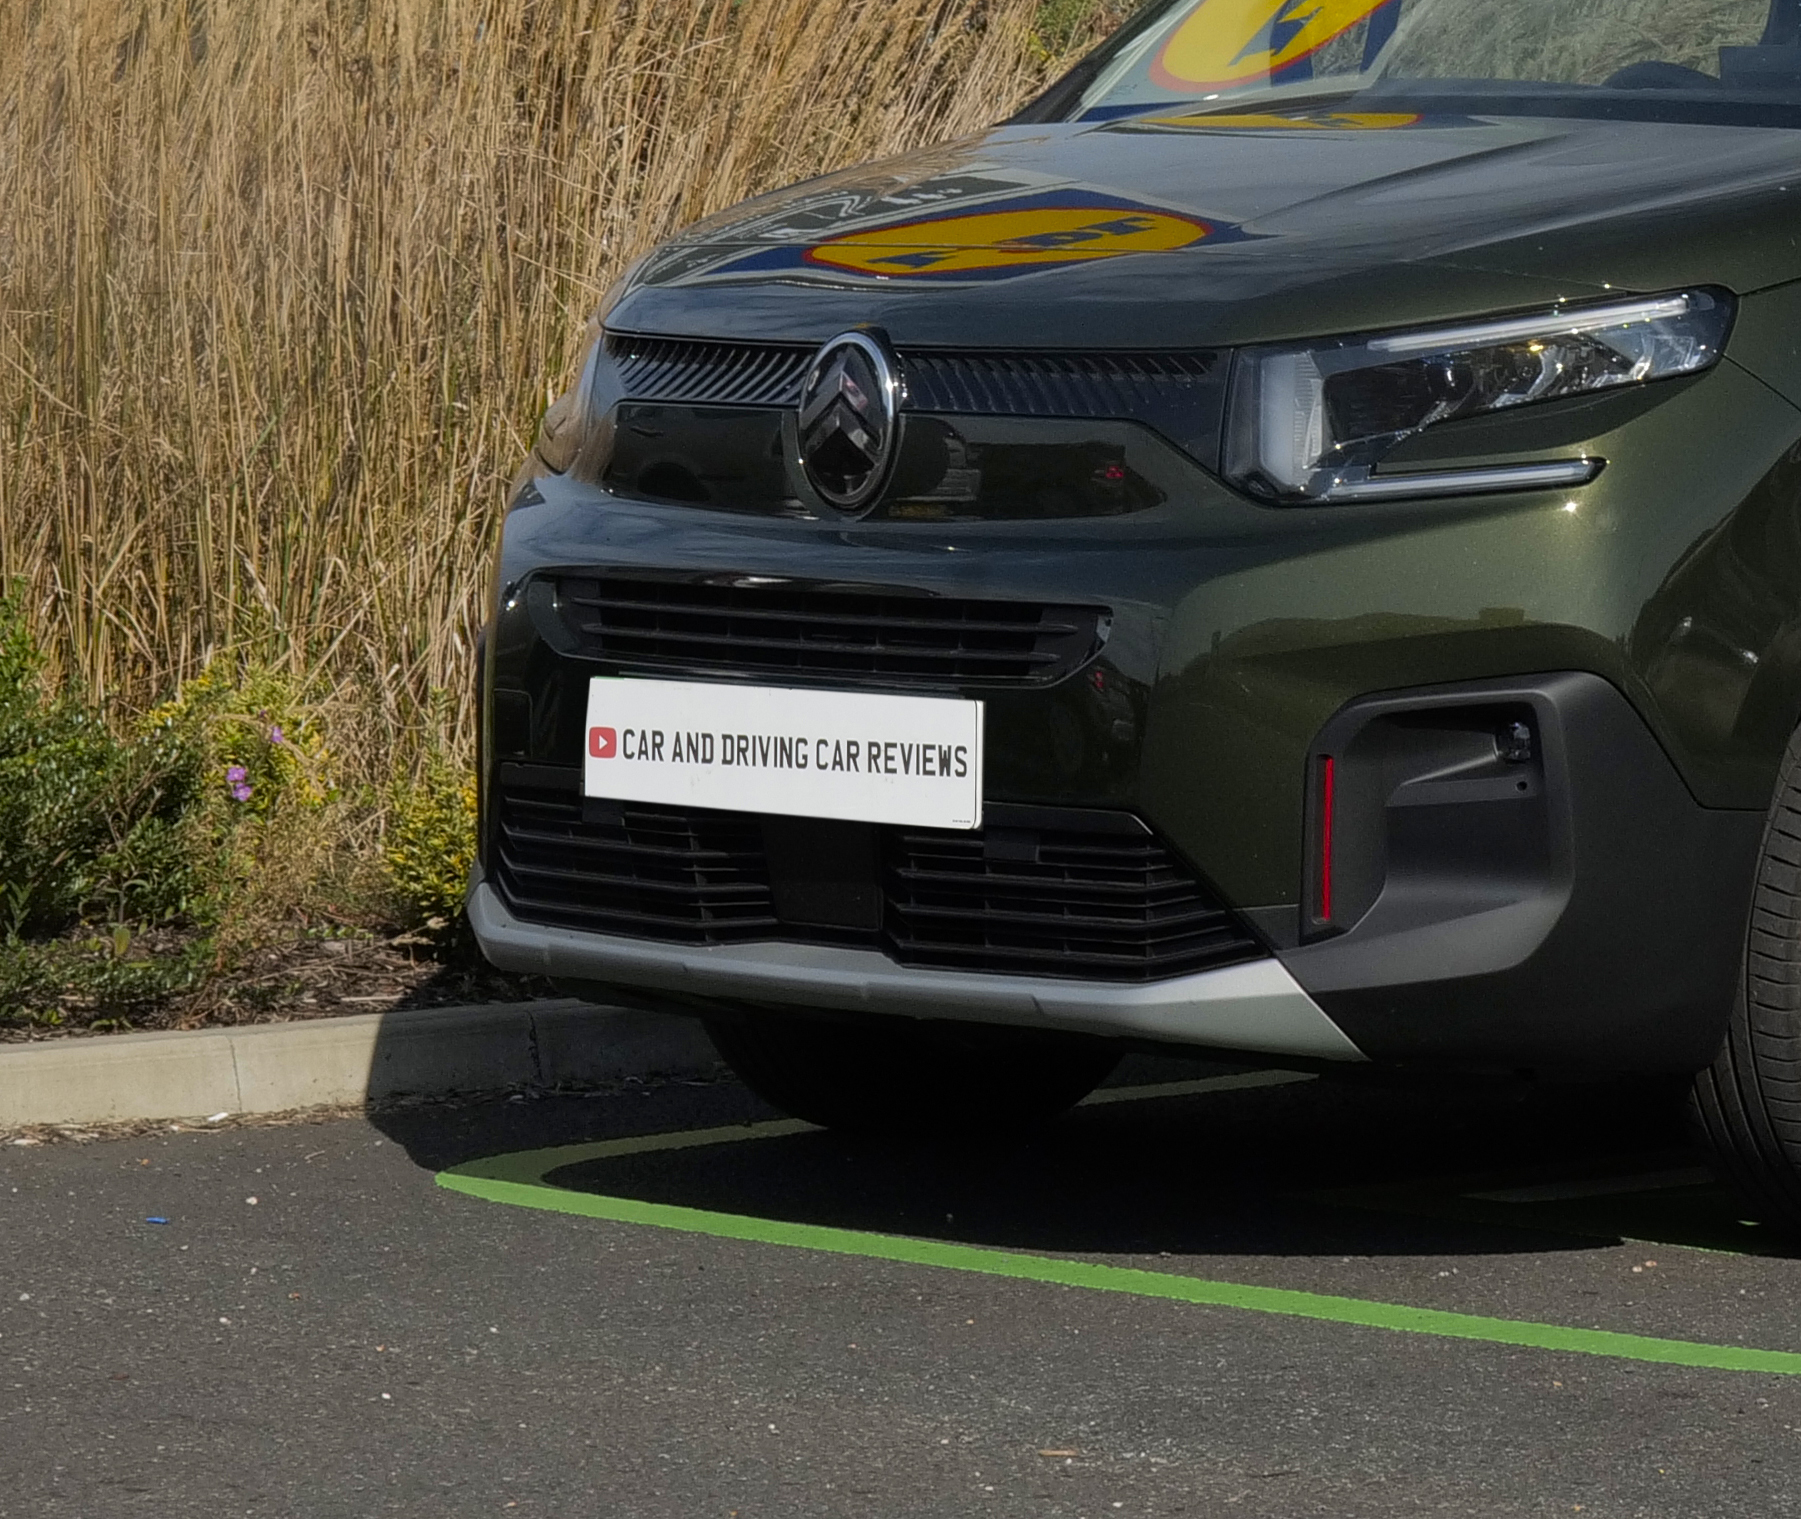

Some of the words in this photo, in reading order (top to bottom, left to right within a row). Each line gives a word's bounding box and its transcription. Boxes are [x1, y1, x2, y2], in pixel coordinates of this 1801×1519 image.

[622, 729, 664, 762] CAR
[672, 732, 714, 764] AND
[721, 735, 809, 770] DRIVING
[816, 739, 860, 773] CAR
[867, 742, 968, 778] REVIEWS
